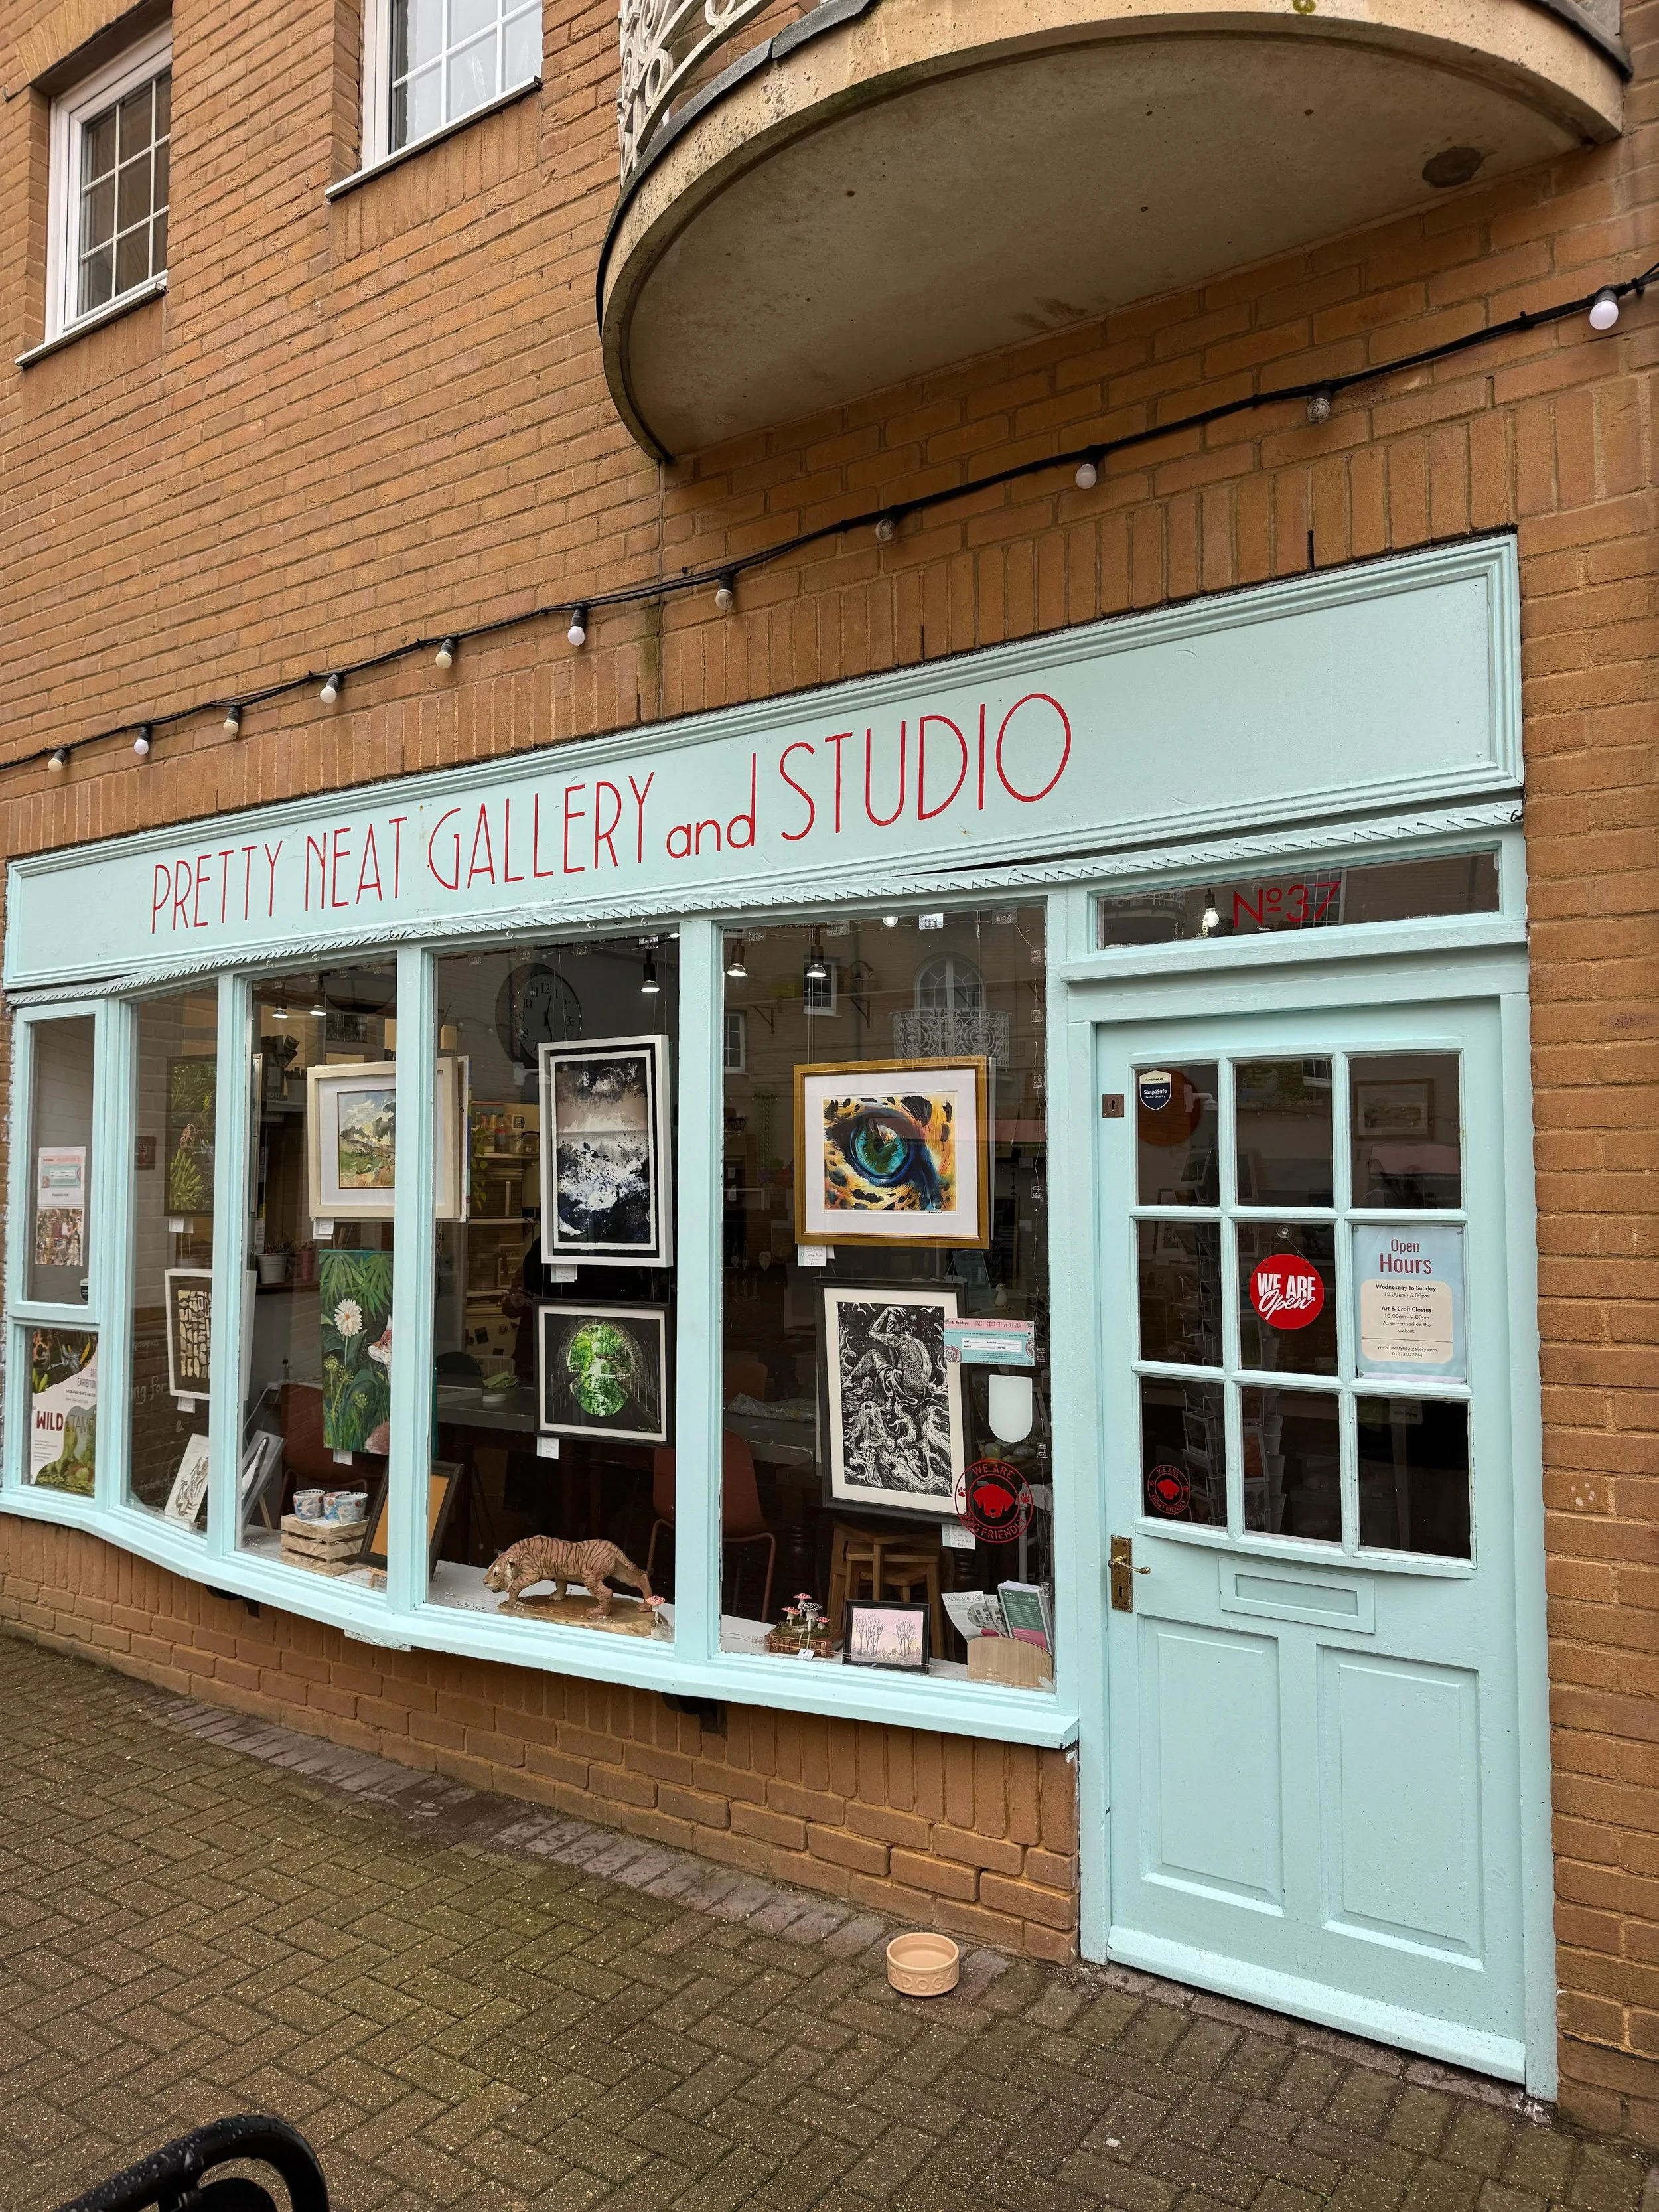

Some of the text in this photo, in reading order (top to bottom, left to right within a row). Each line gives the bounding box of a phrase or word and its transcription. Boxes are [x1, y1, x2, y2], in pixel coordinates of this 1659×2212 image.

[152, 693, 1071, 934] PRETTY NEAT GALLERY and STUDIO
[1390, 1239, 1419, 1254] Open
[1380, 1253, 1432, 1274] Hours
[1257, 1272, 1316, 1301] WE ARE
[1258, 1288, 1313, 1321] Open
[36, 1410, 64, 1431] WILD
[972, 1463, 1015, 1480] WE ARE
[1168, 1467, 1180, 1477] ARE
[1151, 1494, 1187, 1512] DOG FRIENDLY
[961, 1511, 981, 1533] DOG
[980, 1515, 1026, 1540] FRIENDLY
